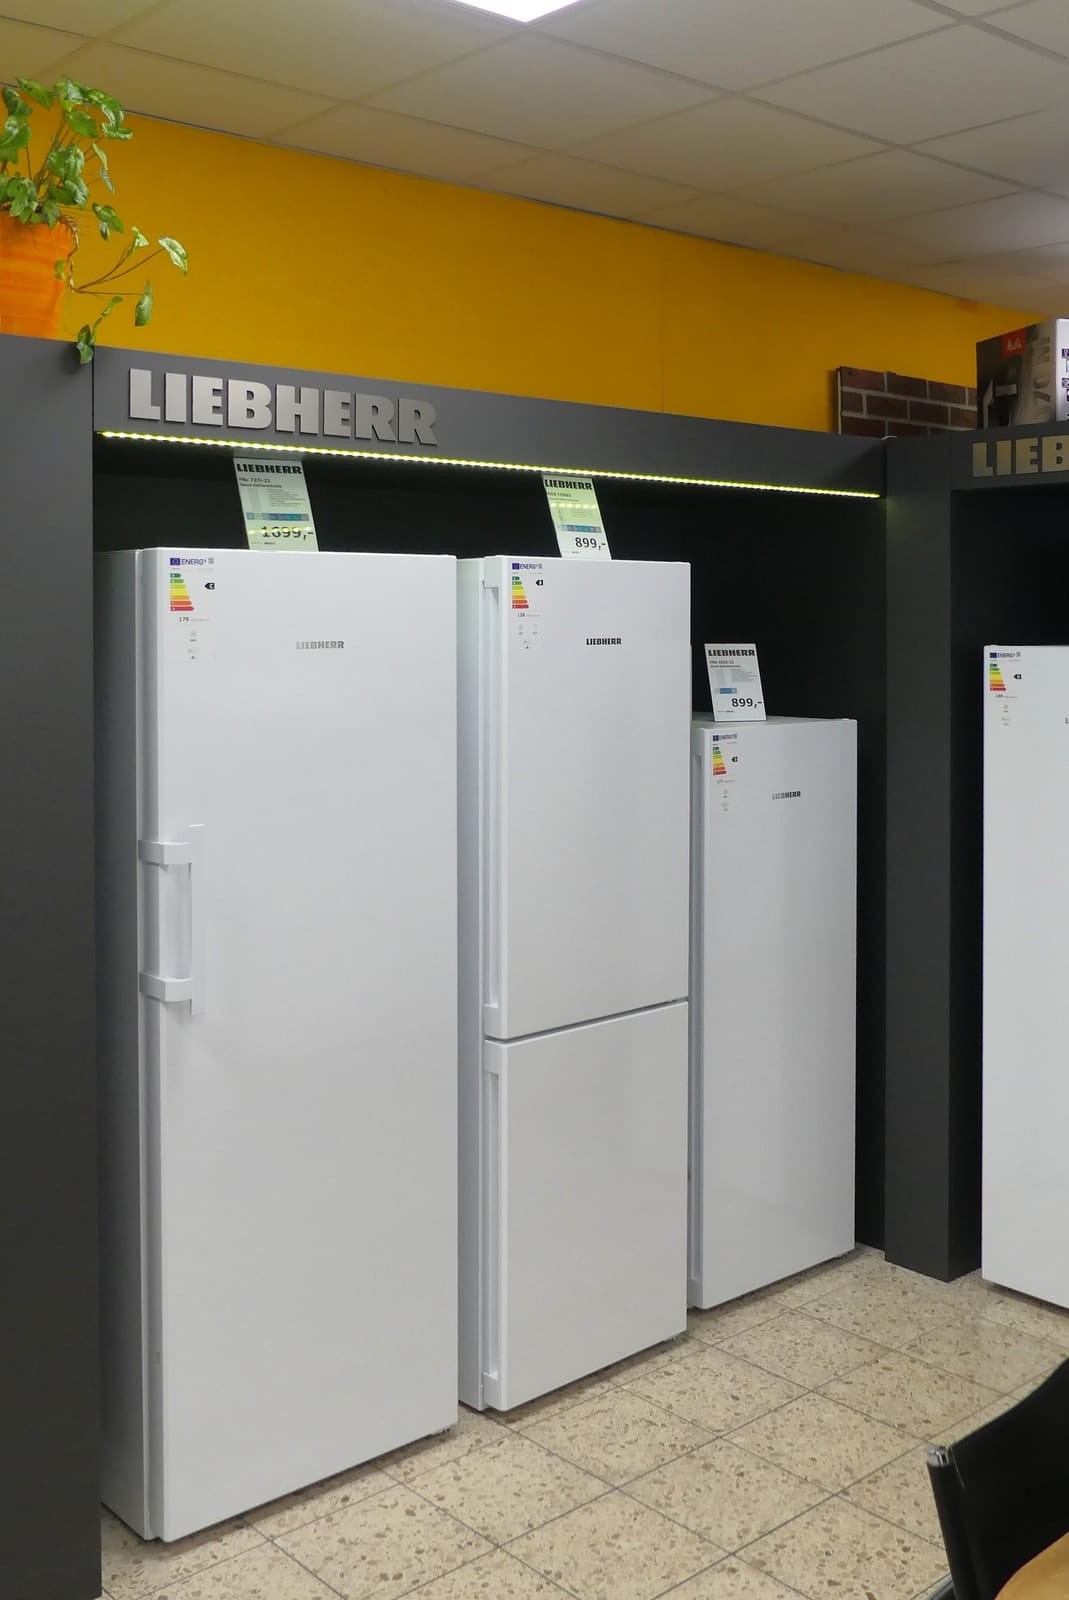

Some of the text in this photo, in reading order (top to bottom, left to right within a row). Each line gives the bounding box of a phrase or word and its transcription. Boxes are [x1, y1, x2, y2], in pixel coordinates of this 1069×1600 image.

[128, 367, 438, 446] LIEBHERR
[236, 463, 303, 475] LIEBHERR
[544, 479, 593, 490] LIEBHERR
[575, 537, 606, 550] 899,-
[296, 641, 344, 650] LIEBHERR
[732, 698, 762, 708] 899,-
[772, 790, 802, 800] LIEBHERR
